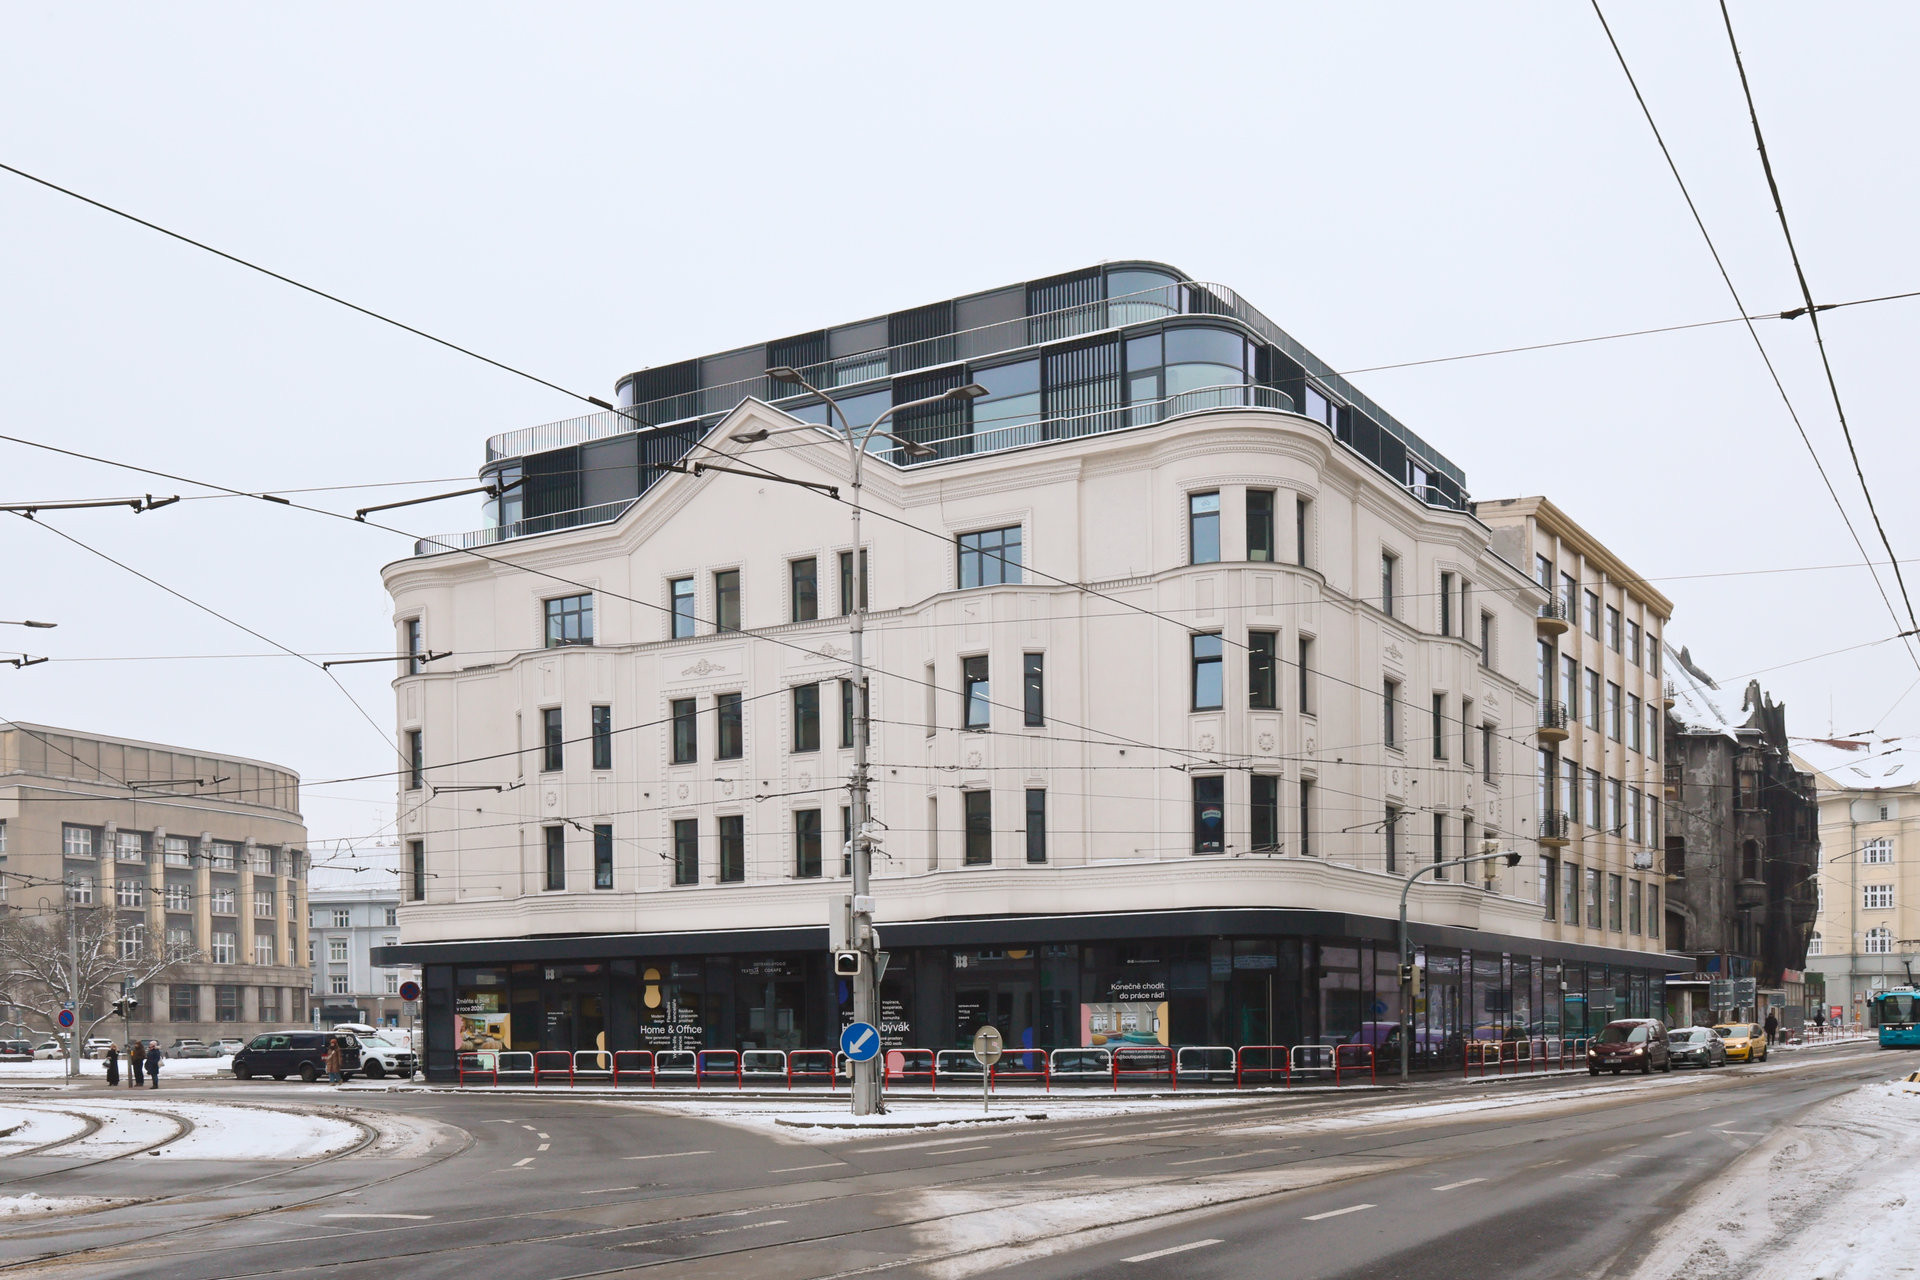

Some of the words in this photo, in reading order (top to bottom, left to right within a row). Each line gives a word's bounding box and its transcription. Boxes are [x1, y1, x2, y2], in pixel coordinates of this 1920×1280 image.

[1111, 982, 1142, 990] Konečně
[1130, 992, 1150, 1000] práce
[640, 1025, 665, 1034] Home
[668, 1025, 675, 1034] &
[676, 1025, 702, 1033] Office
[880, 1022, 910, 1034] bývák
